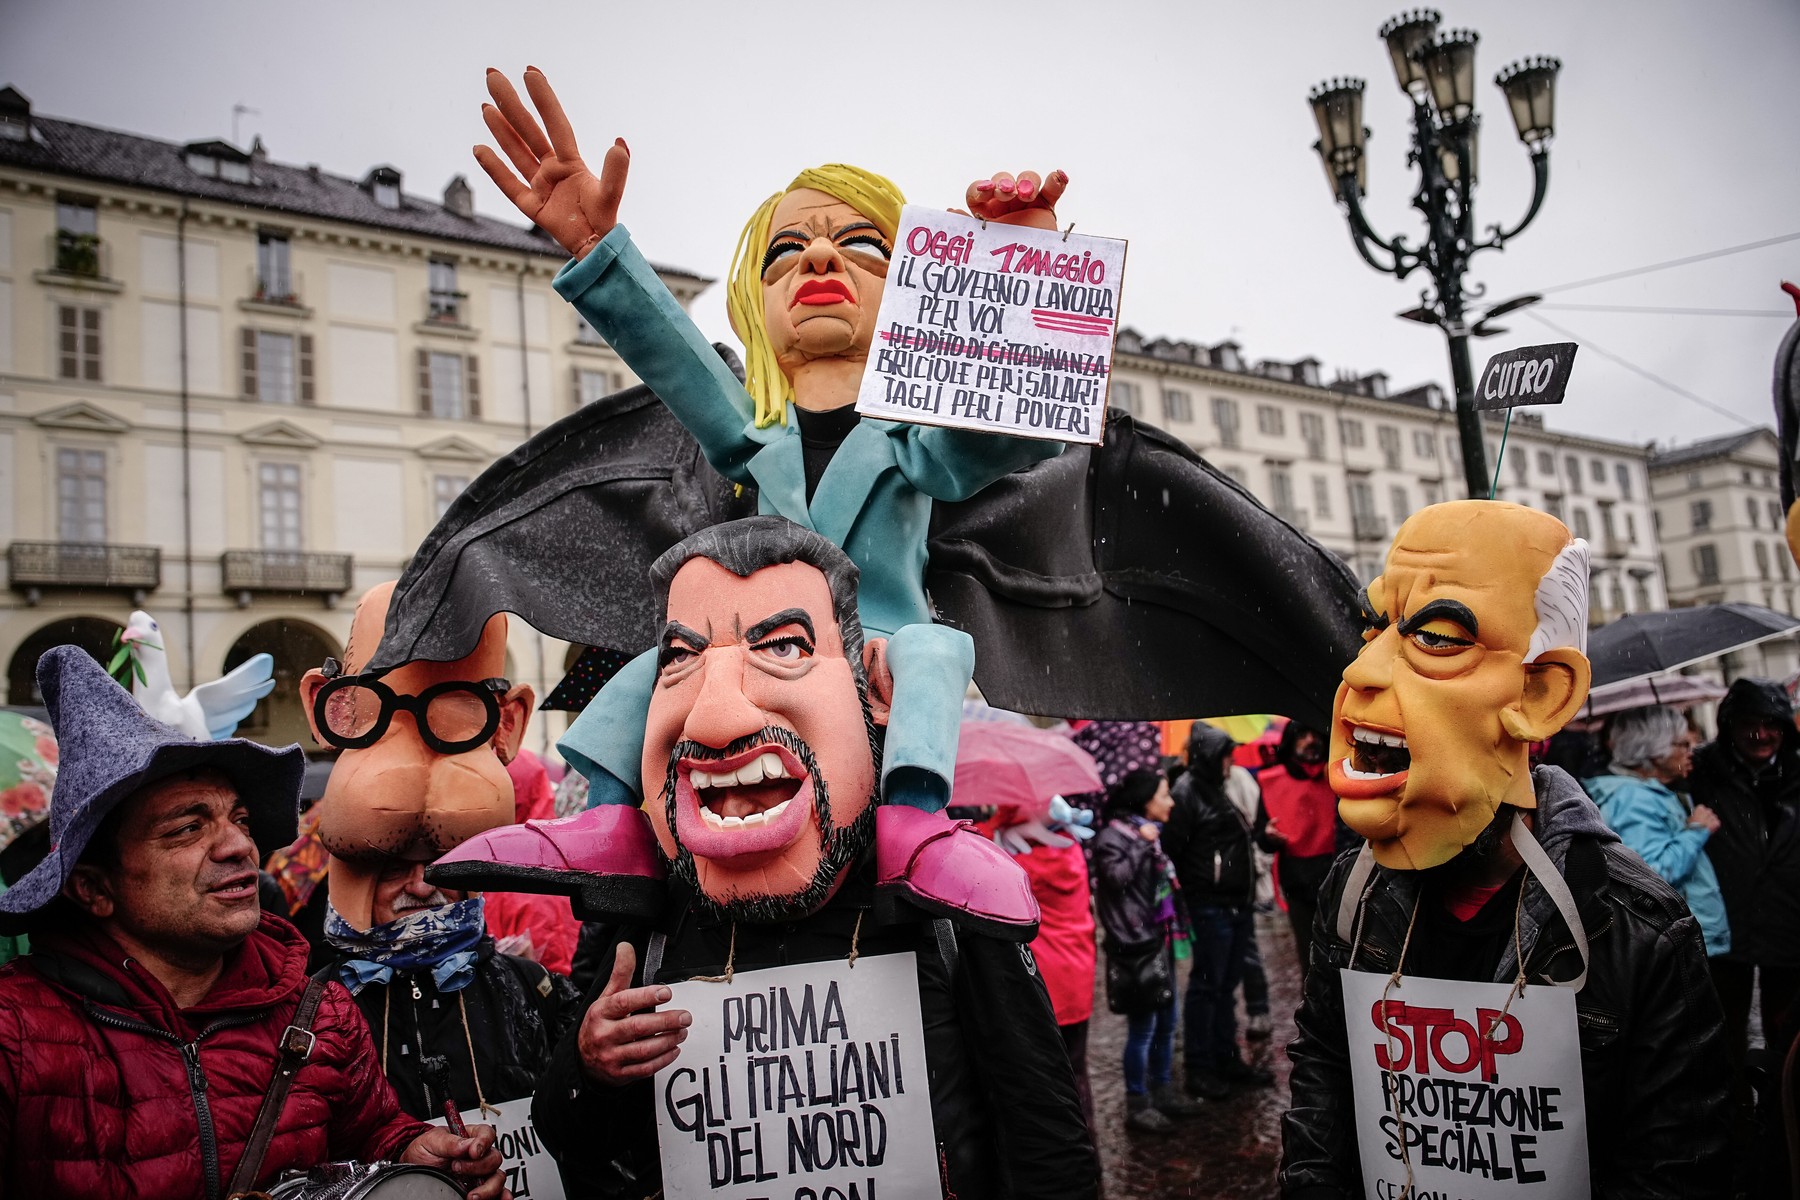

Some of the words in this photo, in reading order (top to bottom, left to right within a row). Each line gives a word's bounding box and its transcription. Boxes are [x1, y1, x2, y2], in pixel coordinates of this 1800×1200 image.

[907, 226, 974, 265] OGGI
[897, 255, 917, 289] IL
[922, 261, 1030, 307] GOVERNO
[1034, 279, 1114, 318] LAVORA
[917, 295, 959, 331] PER
[968, 300, 1005, 334] VOI
[888, 321, 965, 356] REDDITO
[875, 347, 973, 386] BRICIOLE
[976, 364, 1016, 395] PER
[1025, 371, 1099, 406] SALARI
[884, 376, 943, 414] TAGLI
[951, 388, 993, 422] PER
[995, 394, 1003, 422] I
[1015, 397, 1090, 435] POVERI
[723, 980, 849, 1054] PRIMA
[1371, 1000, 1524, 1082] STOP
[665, 1055, 732, 1142] GLI
[747, 1033, 905, 1119] ITALIANI
[1381, 1071, 1564, 1132] PROTEZIONE
[706, 1122, 778, 1189] DEL
[788, 1103, 887, 1175] NORD
[1379, 1115, 1546, 1184] SPECIALE
